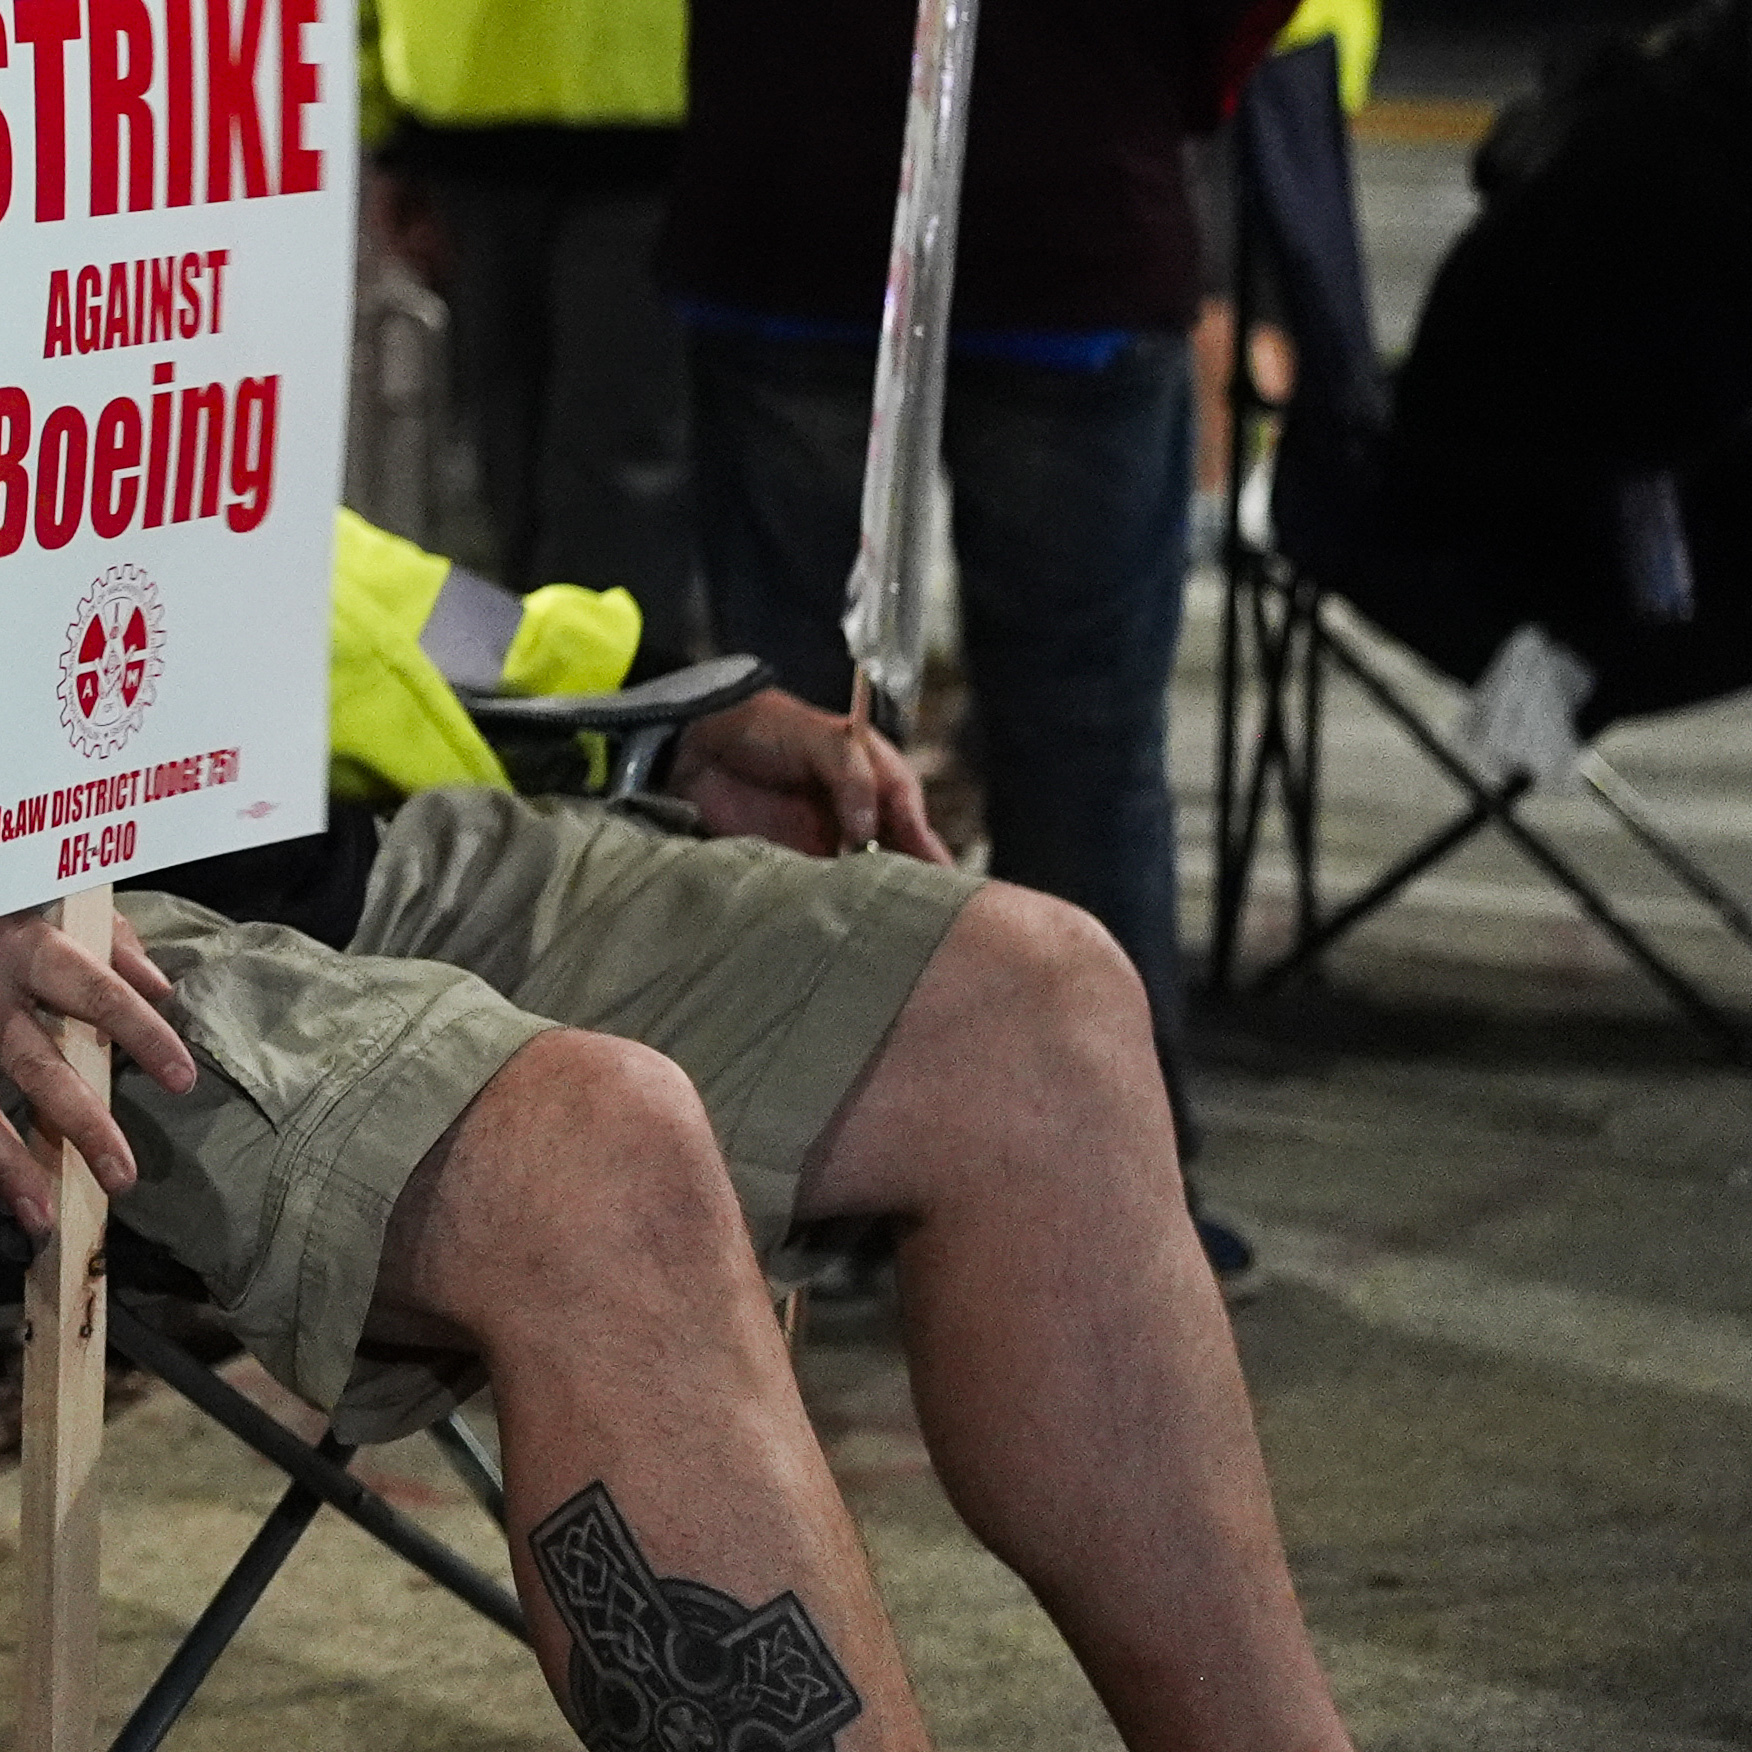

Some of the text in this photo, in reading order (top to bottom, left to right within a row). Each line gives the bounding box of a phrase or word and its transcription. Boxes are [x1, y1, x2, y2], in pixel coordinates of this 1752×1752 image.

[42, 247, 232, 361] AGAINST
[51, 769, 141, 829] DISTRICT
[57, 819, 138, 880] AFL-CIO
